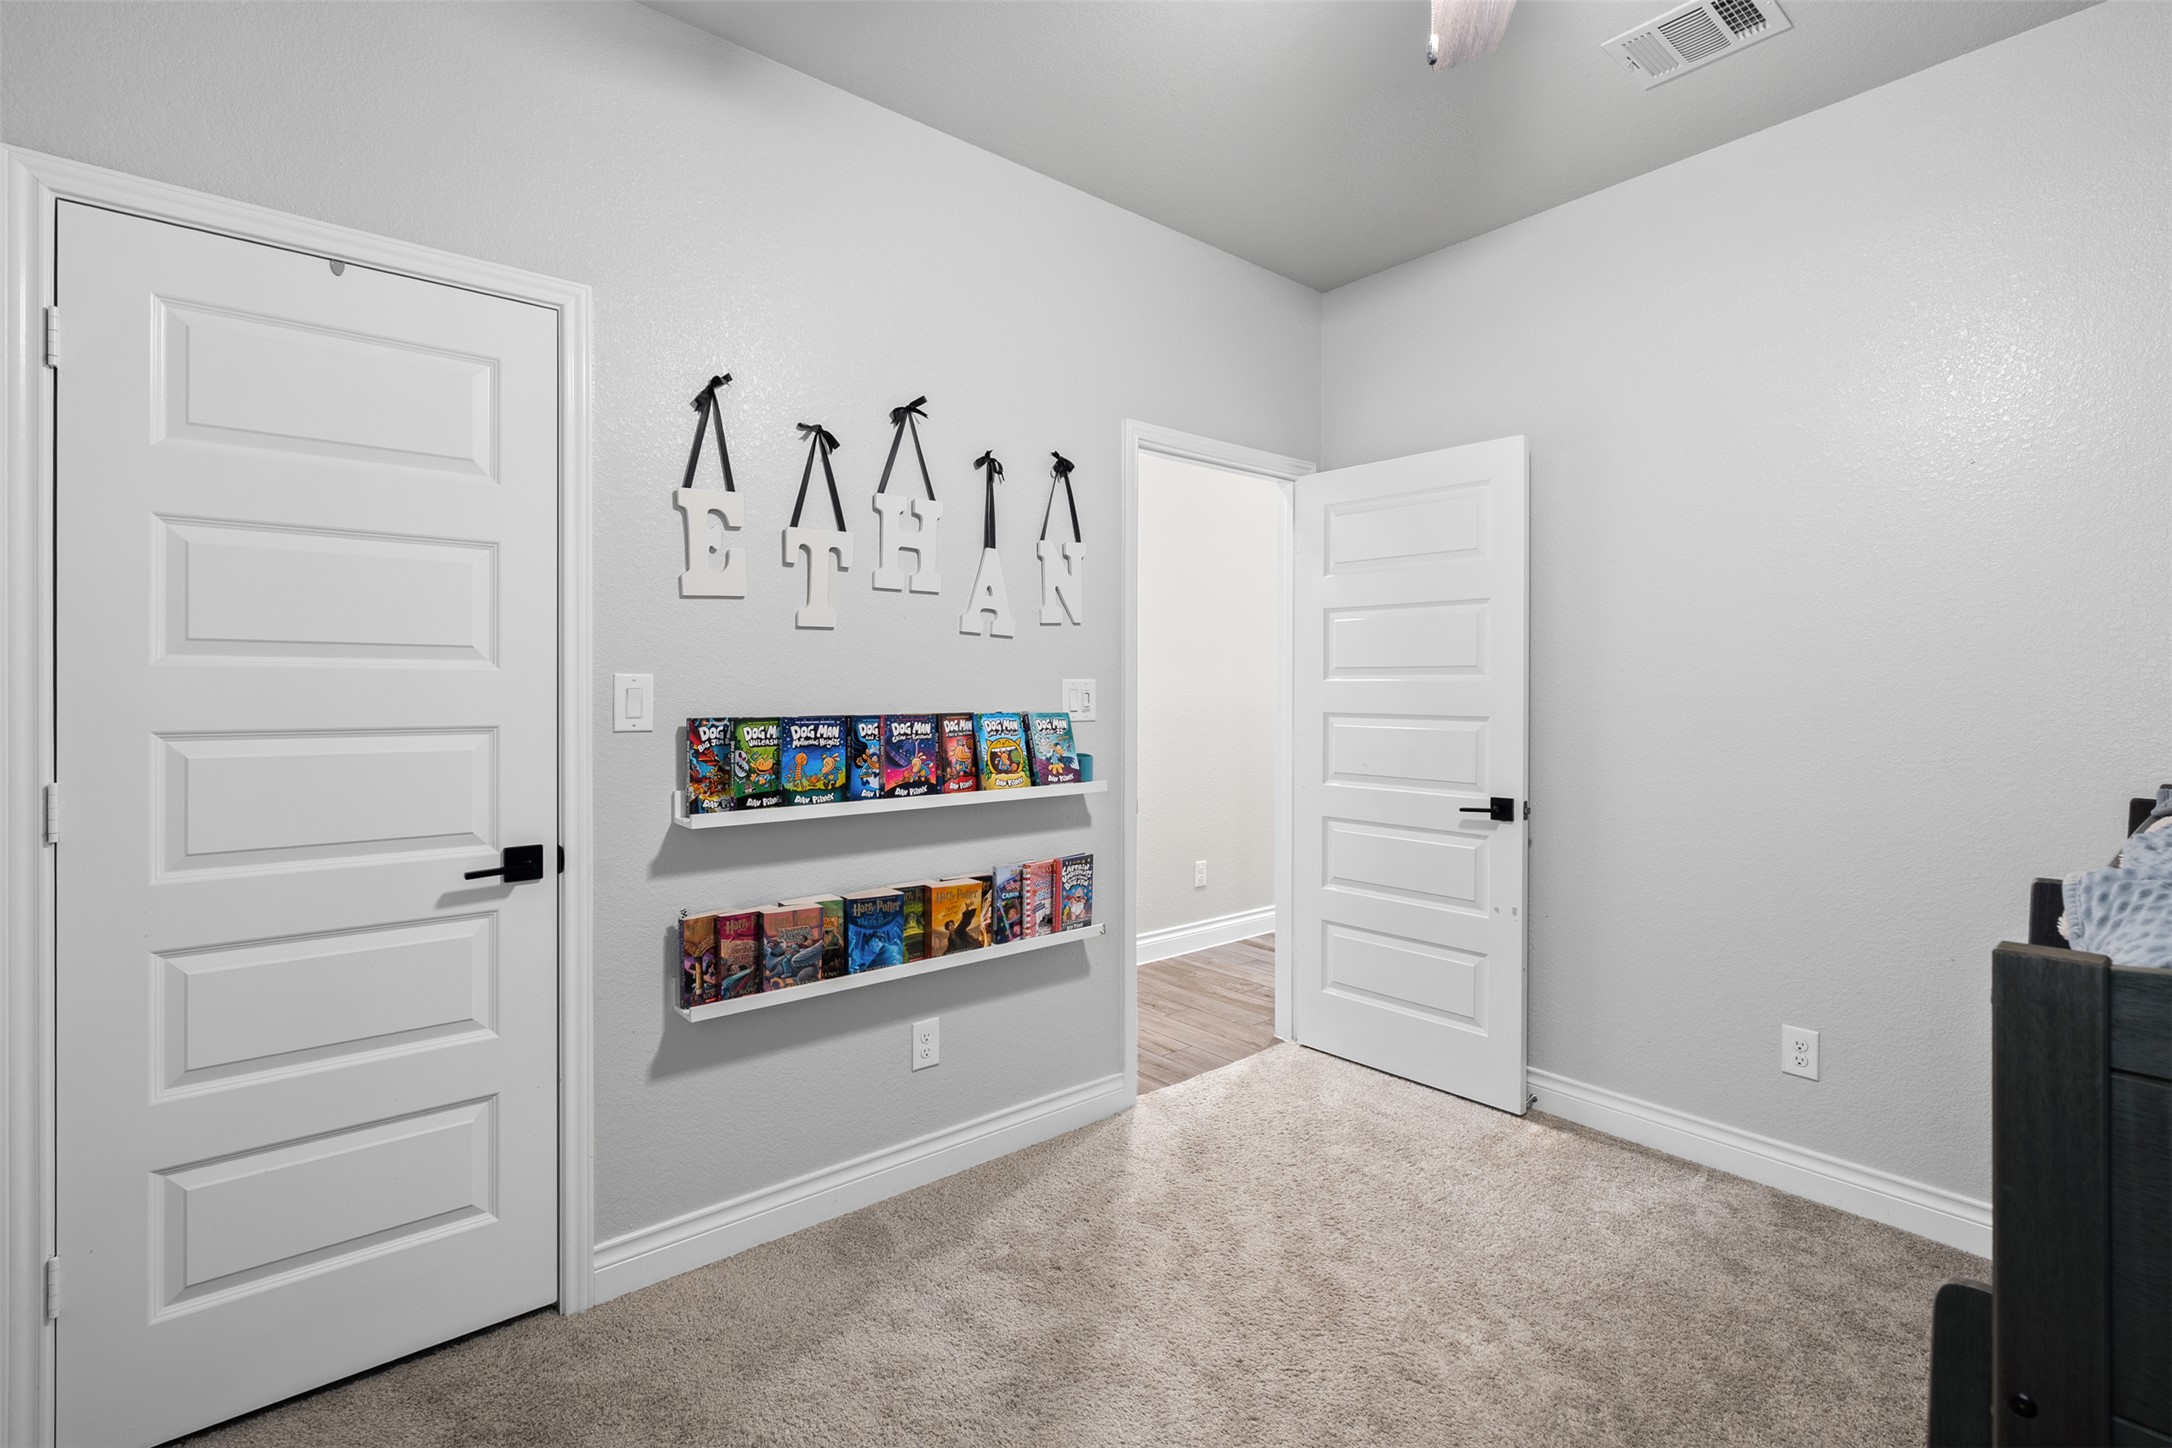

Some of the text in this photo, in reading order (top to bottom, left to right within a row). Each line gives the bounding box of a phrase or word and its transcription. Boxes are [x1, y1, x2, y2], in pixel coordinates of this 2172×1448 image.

[672, 487, 1087, 639] ETHAN
[790, 724, 840, 740] DOG MAN
[858, 722, 879, 737] DOG
[891, 722, 912, 736] DOG
[912, 721, 931, 734] MAN
[943, 719, 959, 734] DOG
[959, 719, 973, 731] MAN
[984, 719, 1018, 732] DOG MAN
[1035, 718, 1067, 731] DOG MAN
[699, 726, 724, 742] DOG
[743, 726, 766, 742] DOG
[794, 795, 810, 804] DAV
[861, 789, 874, 797] DAV
[894, 787, 908, 797] DAV
[703, 799, 719, 809] DAV
[746, 797, 761, 807] DAV
[852, 898, 901, 917] Harry Potter
[725, 918, 750, 935] Harry
